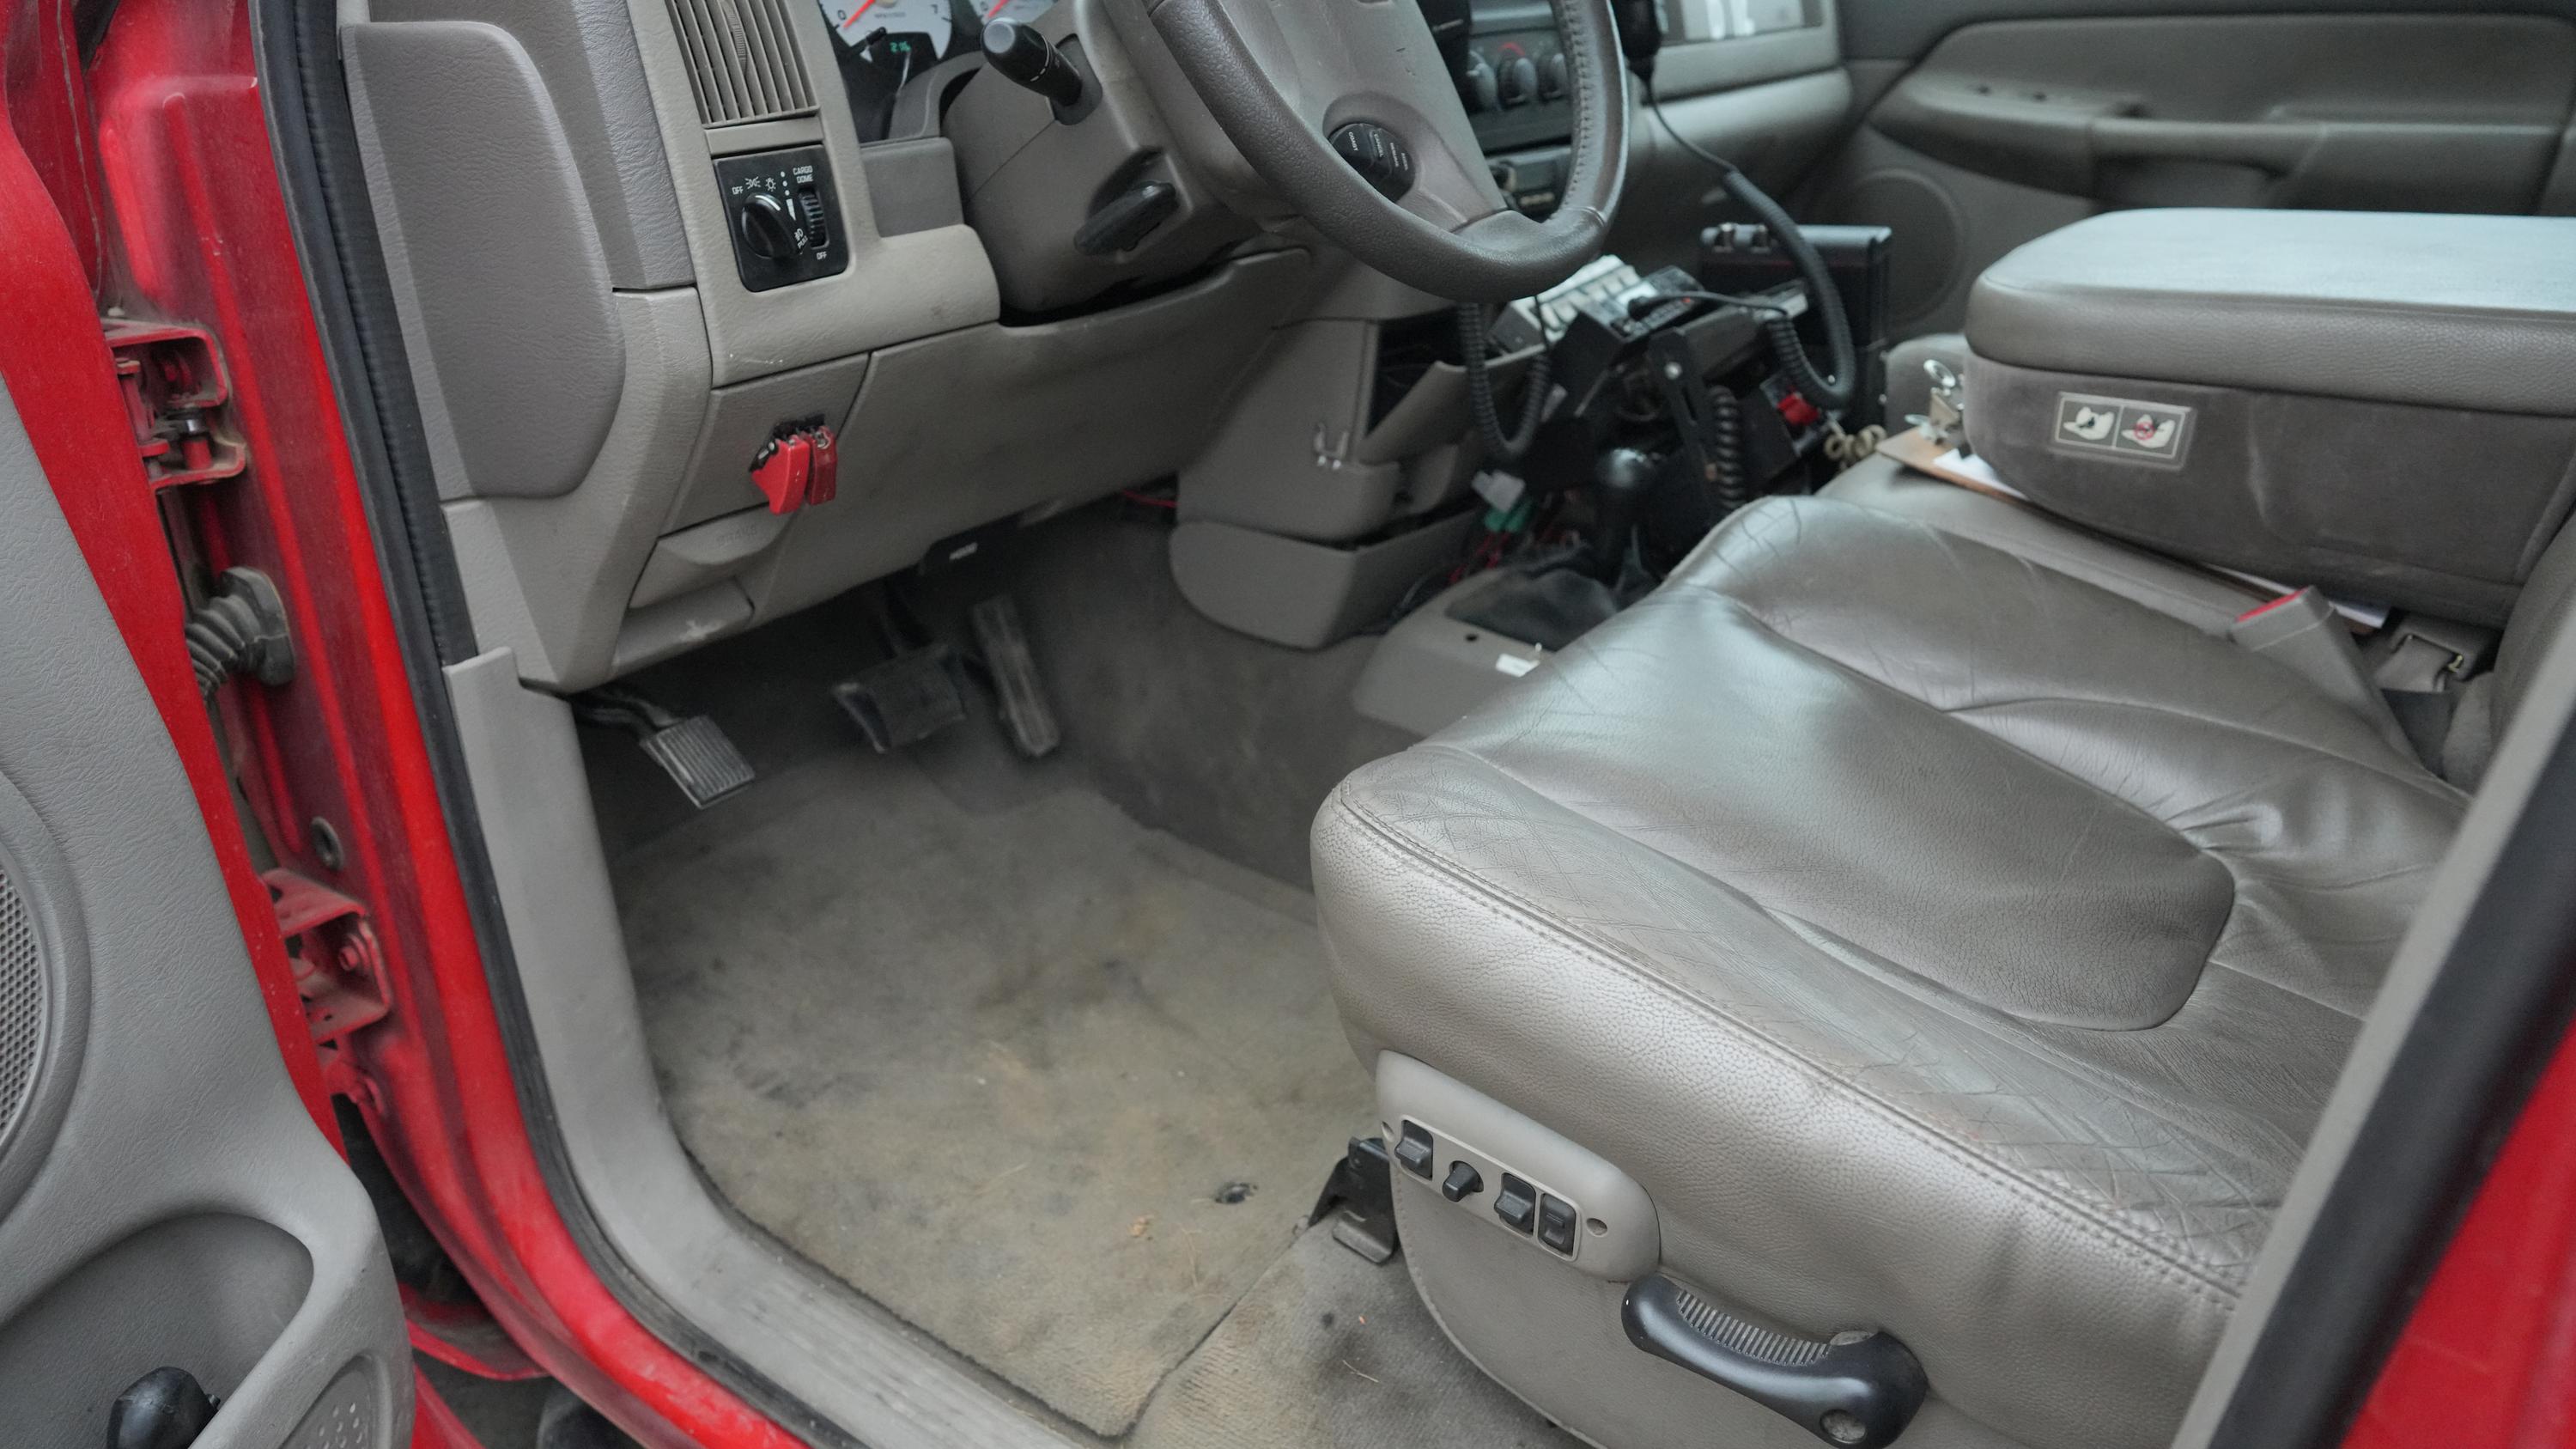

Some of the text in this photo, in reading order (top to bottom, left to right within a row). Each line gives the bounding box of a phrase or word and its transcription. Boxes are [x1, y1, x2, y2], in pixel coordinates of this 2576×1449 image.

[930, 4, 939, 14] 7
[837, 9, 847, 21] 0
[1349, 131, 1358, 151] COAST
[1374, 133, 1383, 157] CANCEL
[793, 165, 813, 175] CARGO
[797, 175, 813, 184] DOME
[732, 186, 744, 195] OFF
